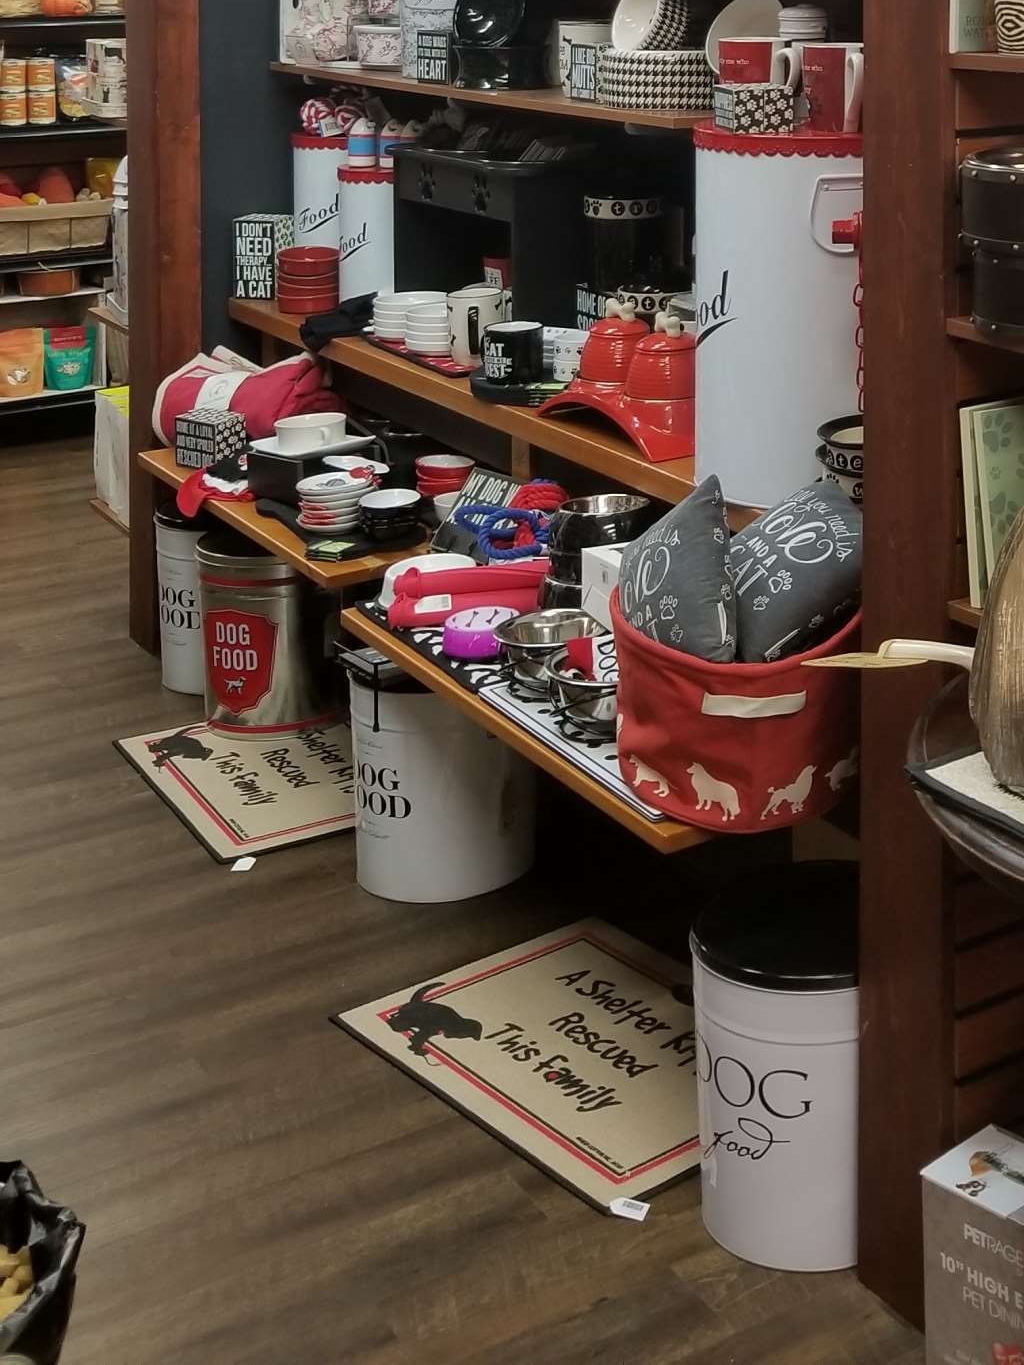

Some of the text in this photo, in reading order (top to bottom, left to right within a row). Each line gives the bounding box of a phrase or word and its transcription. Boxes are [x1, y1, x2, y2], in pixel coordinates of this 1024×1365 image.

[576, 48, 587, 64] LIKE
[418, 59, 447, 81] HEART
[572, 64, 595, 90] MUTTS
[299, 193, 340, 233] Food
[235, 222, 272, 237] I DON'T
[235, 237, 272, 256] NEED
[236, 266, 273, 281] I HAVE
[236, 281, 273, 299] A CAT
[577, 289, 596, 314] HOME
[462, 472, 508, 505] MY DOG
[746, 536, 778, 568] AND A
[216, 621, 251, 646] DOG
[213, 648, 258, 672] FOOD
[210, 751, 241, 775] This
[260, 748, 320, 789] Rescued
[555, 969, 672, 1037] A Shelter
[484, 1022, 541, 1063] This
[548, 1012, 659, 1080] Rescued
[967, 1266, 1009, 1302] HIGH
[963, 1287, 985, 1311] PET
